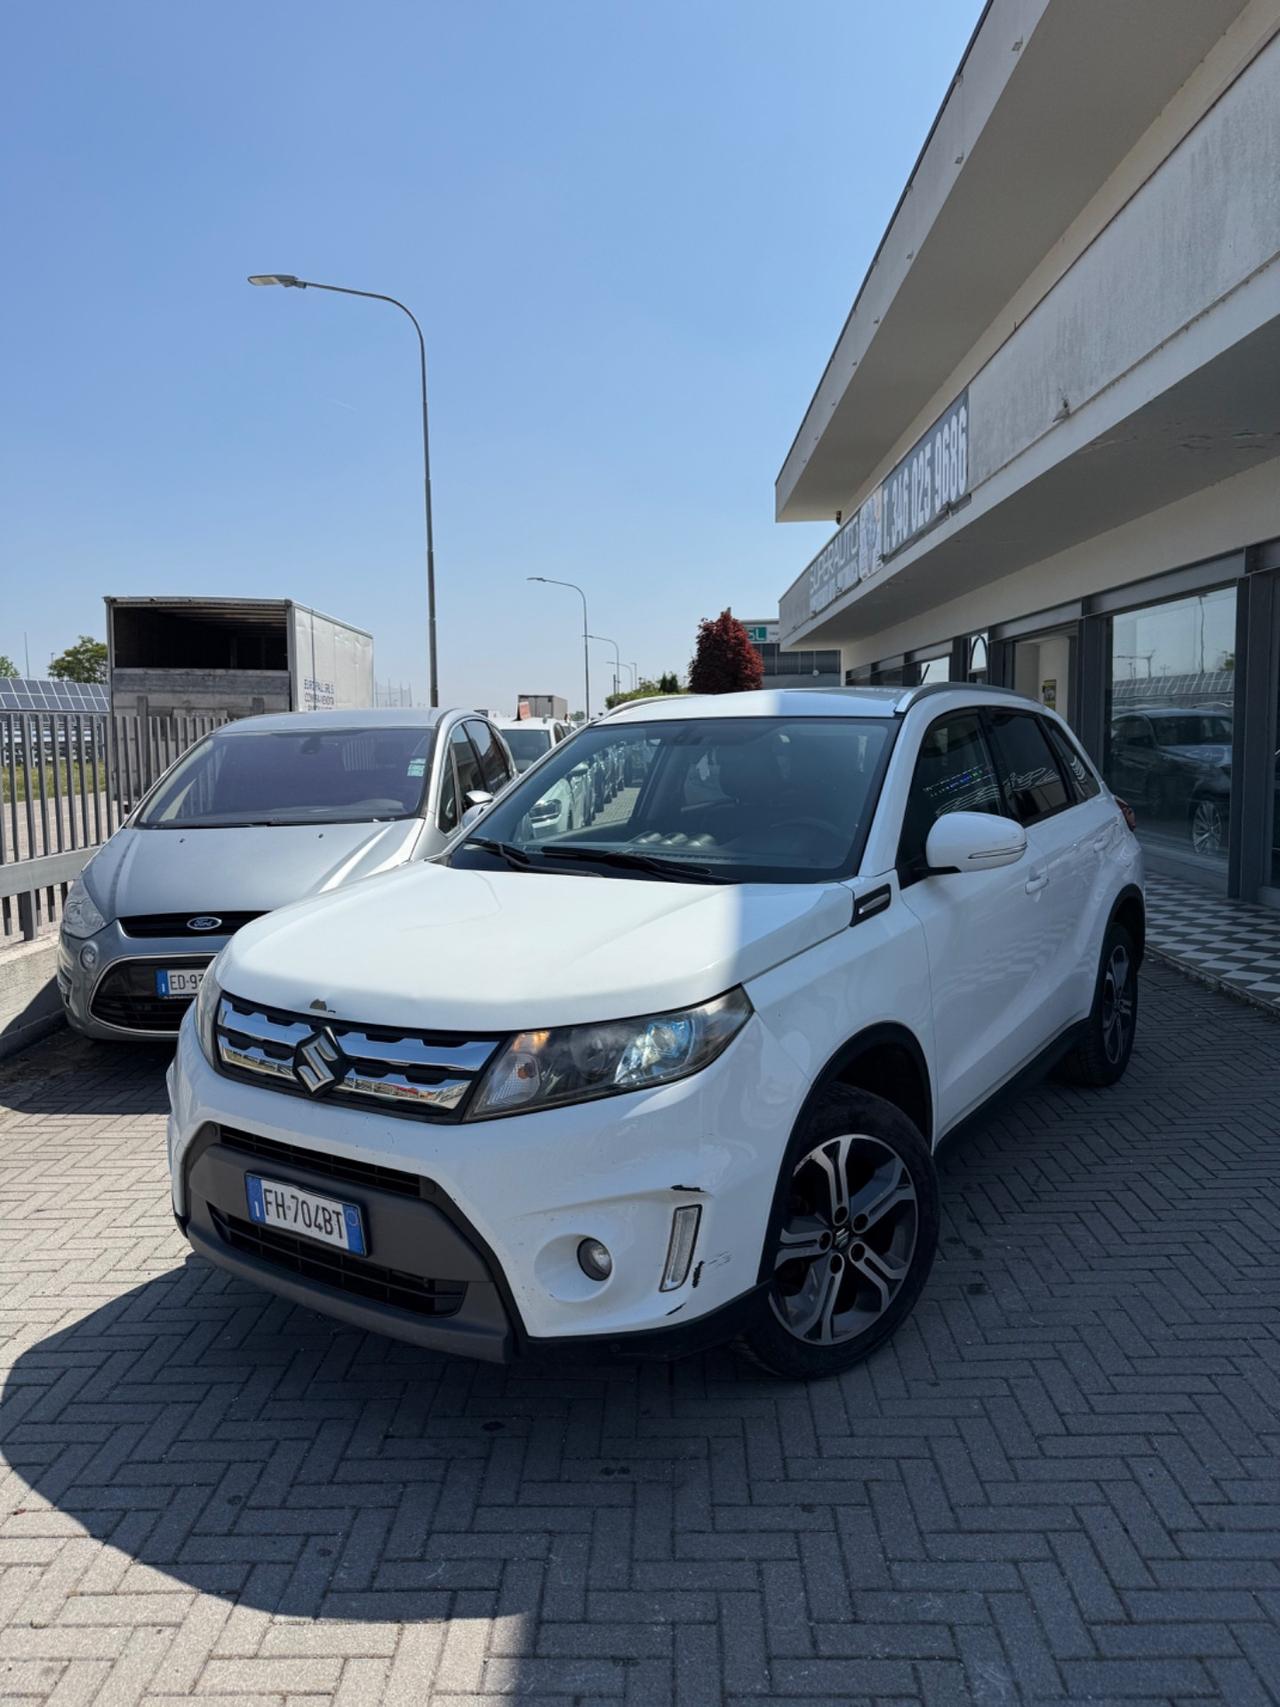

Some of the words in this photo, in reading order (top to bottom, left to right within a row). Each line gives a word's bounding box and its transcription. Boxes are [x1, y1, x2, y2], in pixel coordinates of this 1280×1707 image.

[891, 466, 909, 548] 346
[911, 441, 932, 533] 025
[935, 405, 967, 514] 9686
